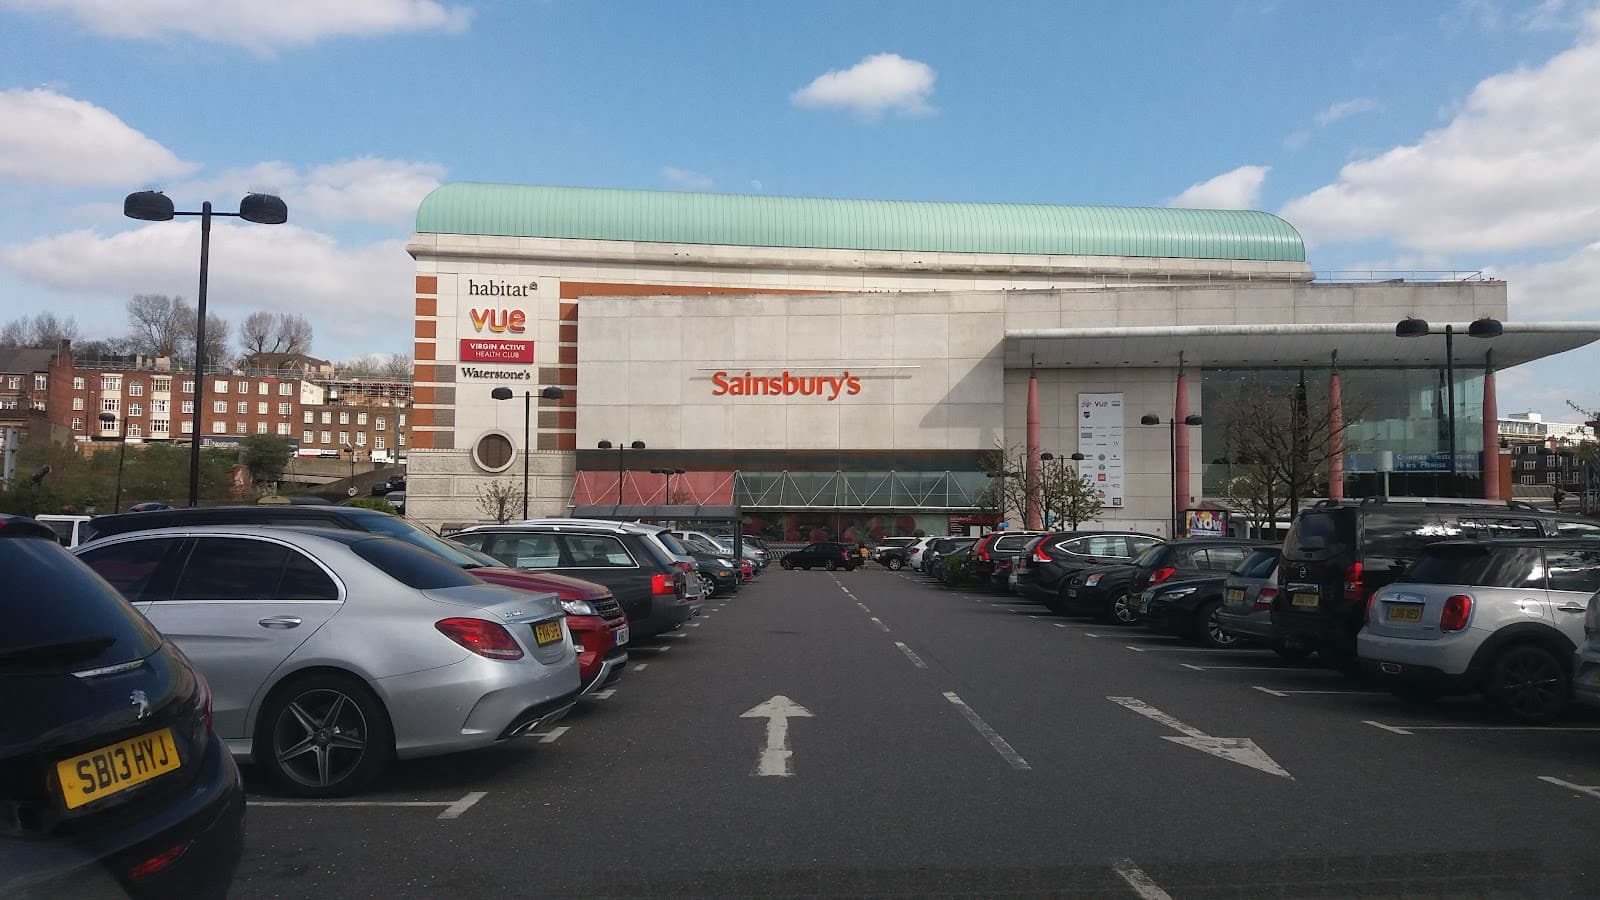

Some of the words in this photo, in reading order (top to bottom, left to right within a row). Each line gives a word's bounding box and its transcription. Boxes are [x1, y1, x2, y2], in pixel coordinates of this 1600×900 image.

[469, 279, 528, 297] habitat
[502, 351, 520, 359] CLUB
[461, 367, 531, 380] Waterstone's
[711, 371, 861, 401] Sainsbury's
[76, 746, 132, 795] SB13
[130, 735, 169, 776] HYJ
